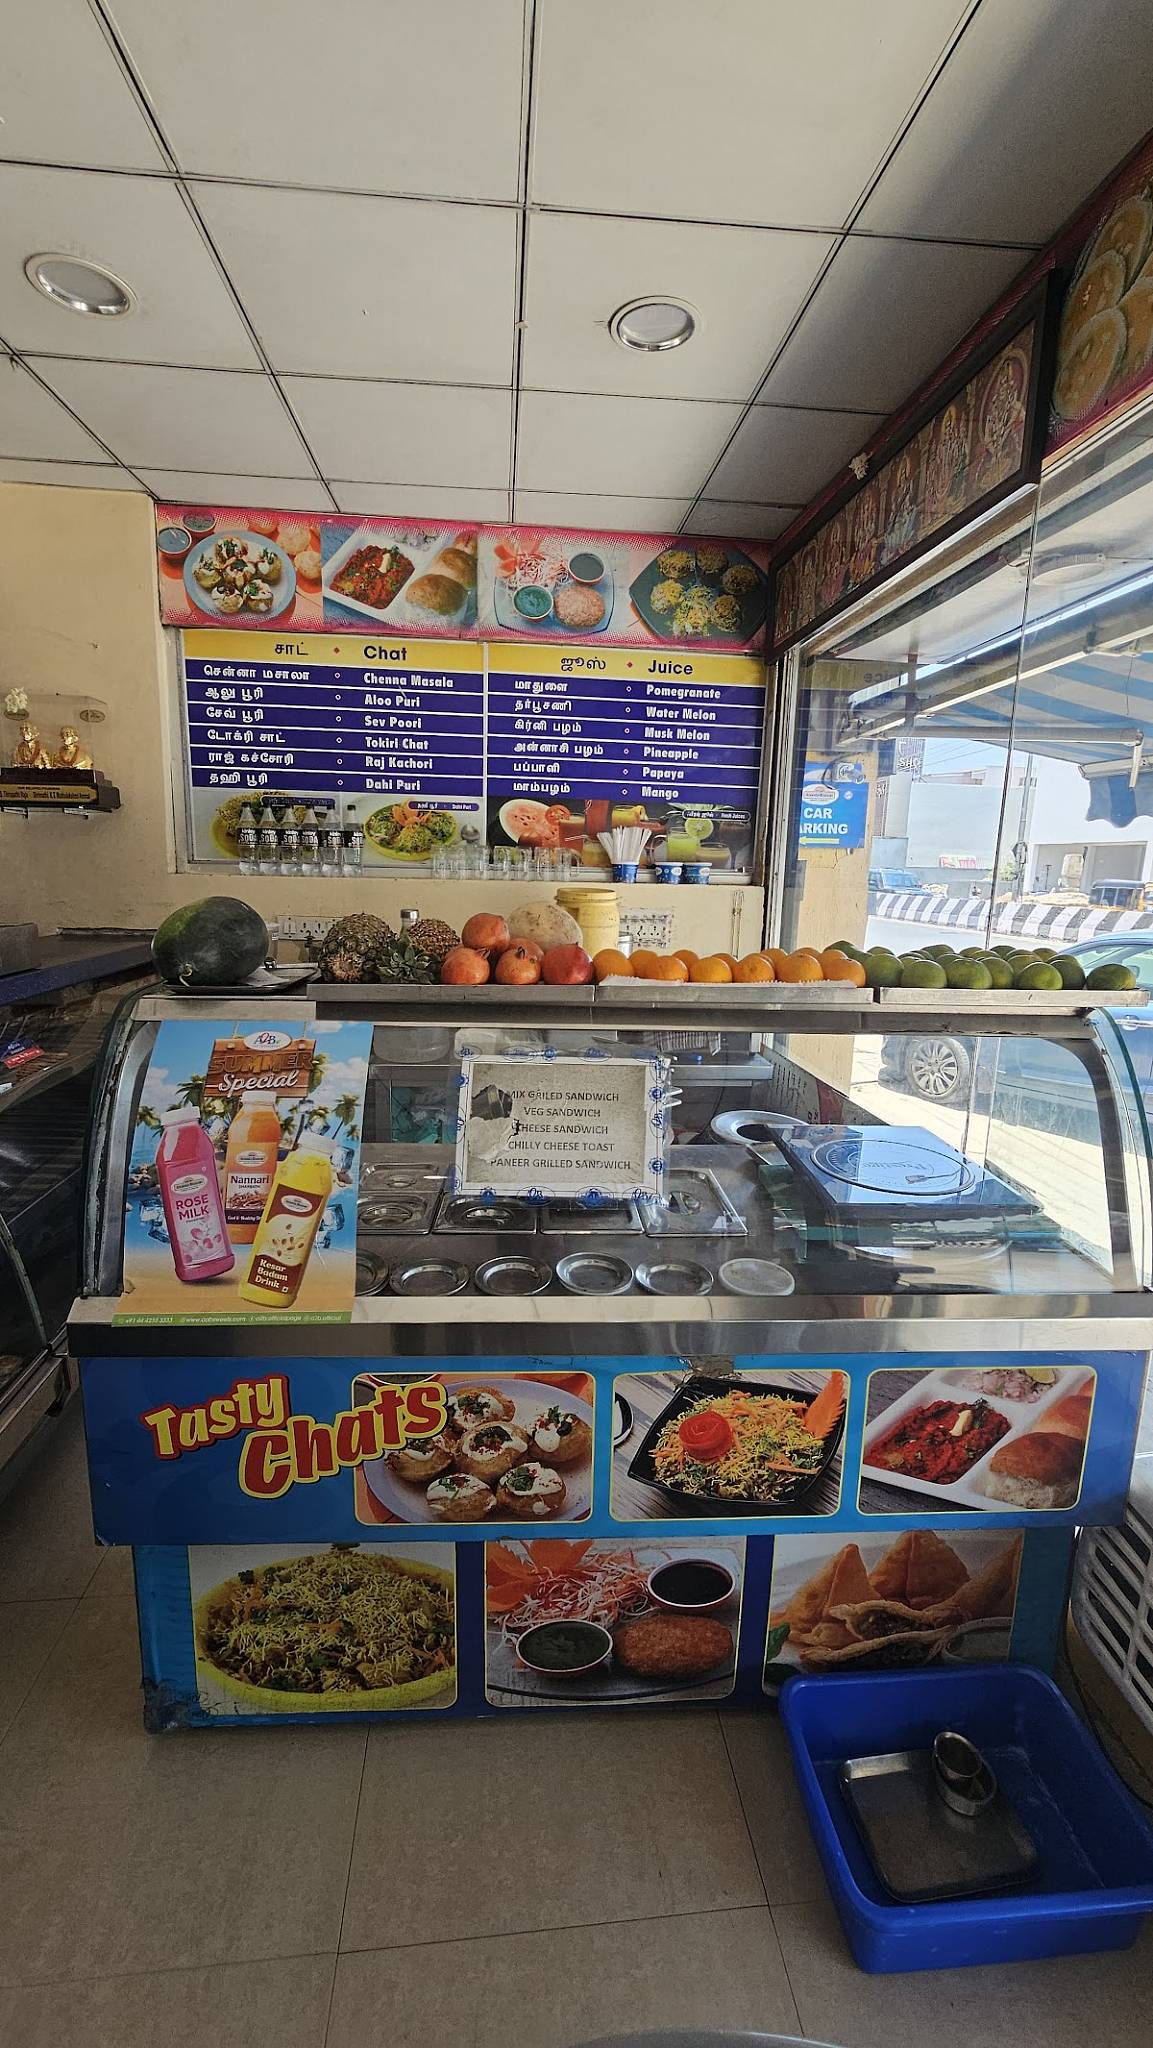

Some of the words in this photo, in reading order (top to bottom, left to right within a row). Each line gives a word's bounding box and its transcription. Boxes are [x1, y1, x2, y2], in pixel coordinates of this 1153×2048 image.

[274, 642, 309, 656] சாட்
[364, 646, 408, 660] Chat
[560, 656, 606, 672] ஜூஸ்
[648, 660, 694, 674] Juice
[204, 664, 256, 678] சென்னா
[262, 669, 310, 680] மசாலா
[364, 672, 407, 686] Chenna
[410, 674, 454, 688] Masala
[514, 680, 568, 694] மாதுளை
[205, 687, 236, 700] ஆலு
[242, 687, 264, 701] பூரி
[646, 684, 721, 699] Pomegranate
[364, 694, 392, 706] Aloo
[396, 696, 420, 708] Puri
[514, 698, 572, 713] தர்பூசணி
[206, 706, 236, 718] சேவ்
[242, 708, 264, 722] பூரி
[646, 706, 680, 718] Water
[682, 708, 716, 720] Melon
[364, 715, 386, 728] Sev
[389, 716, 422, 729] Poori
[552, 722, 582, 735] பழம்
[207, 729, 254, 742] டோக்ரி
[260, 732, 286, 742] சாட்
[644, 726, 673, 739] Musk
[676, 728, 710, 741] Melon
[365, 736, 399, 748] Tokiri
[402, 738, 428, 750] Chat
[514, 741, 569, 754] அன்னாசி
[574, 744, 604, 758] பழம்
[208, 751, 235, 764] ராஜ்
[240, 752, 294, 766] கச்சோரி
[643, 746, 699, 760] Pineapple
[365, 756, 385, 770] Raj
[388, 756, 434, 770] Kachori
[513, 762, 560, 773] பப்பாளி
[246, 772, 268, 786] பூரி
[642, 766, 684, 780] Papaya
[365, 778, 393, 790] Dahi
[396, 780, 421, 791] Puri
[513, 782, 571, 796] மாம்பழம்
[641, 786, 680, 800] Mango
[804, 808, 832, 819] CAR
[209, 1052, 314, 1074] SUMMER
[218, 1070, 300, 1098] Special
[566, 1092, 619, 1102] SANDWICH
[523, 1106, 544, 1116] VEG
[546, 1108, 601, 1117] SANDWICH
[554, 1125, 608, 1134] SANDWICH
[508, 1141, 540, 1150] CHILLY
[544, 1142, 580, 1151] CHEESE
[582, 1142, 615, 1152] TOAST
[490, 1158, 530, 1168] PANEER
[532, 1159, 573, 1168] GRILLED
[575, 1160, 631, 1170] SANDWICH
[230, 1176, 270, 1184] Nannari
[176, 1194, 209, 1210] ROSE
[178, 1205, 210, 1220] MILK
[260, 1259, 286, 1272] Kesar
[257, 1266, 288, 1282] Badam
[255, 1275, 280, 1288] Drink
[143, 1376, 288, 1457] Tasty
[240, 1383, 446, 1497] Chats
